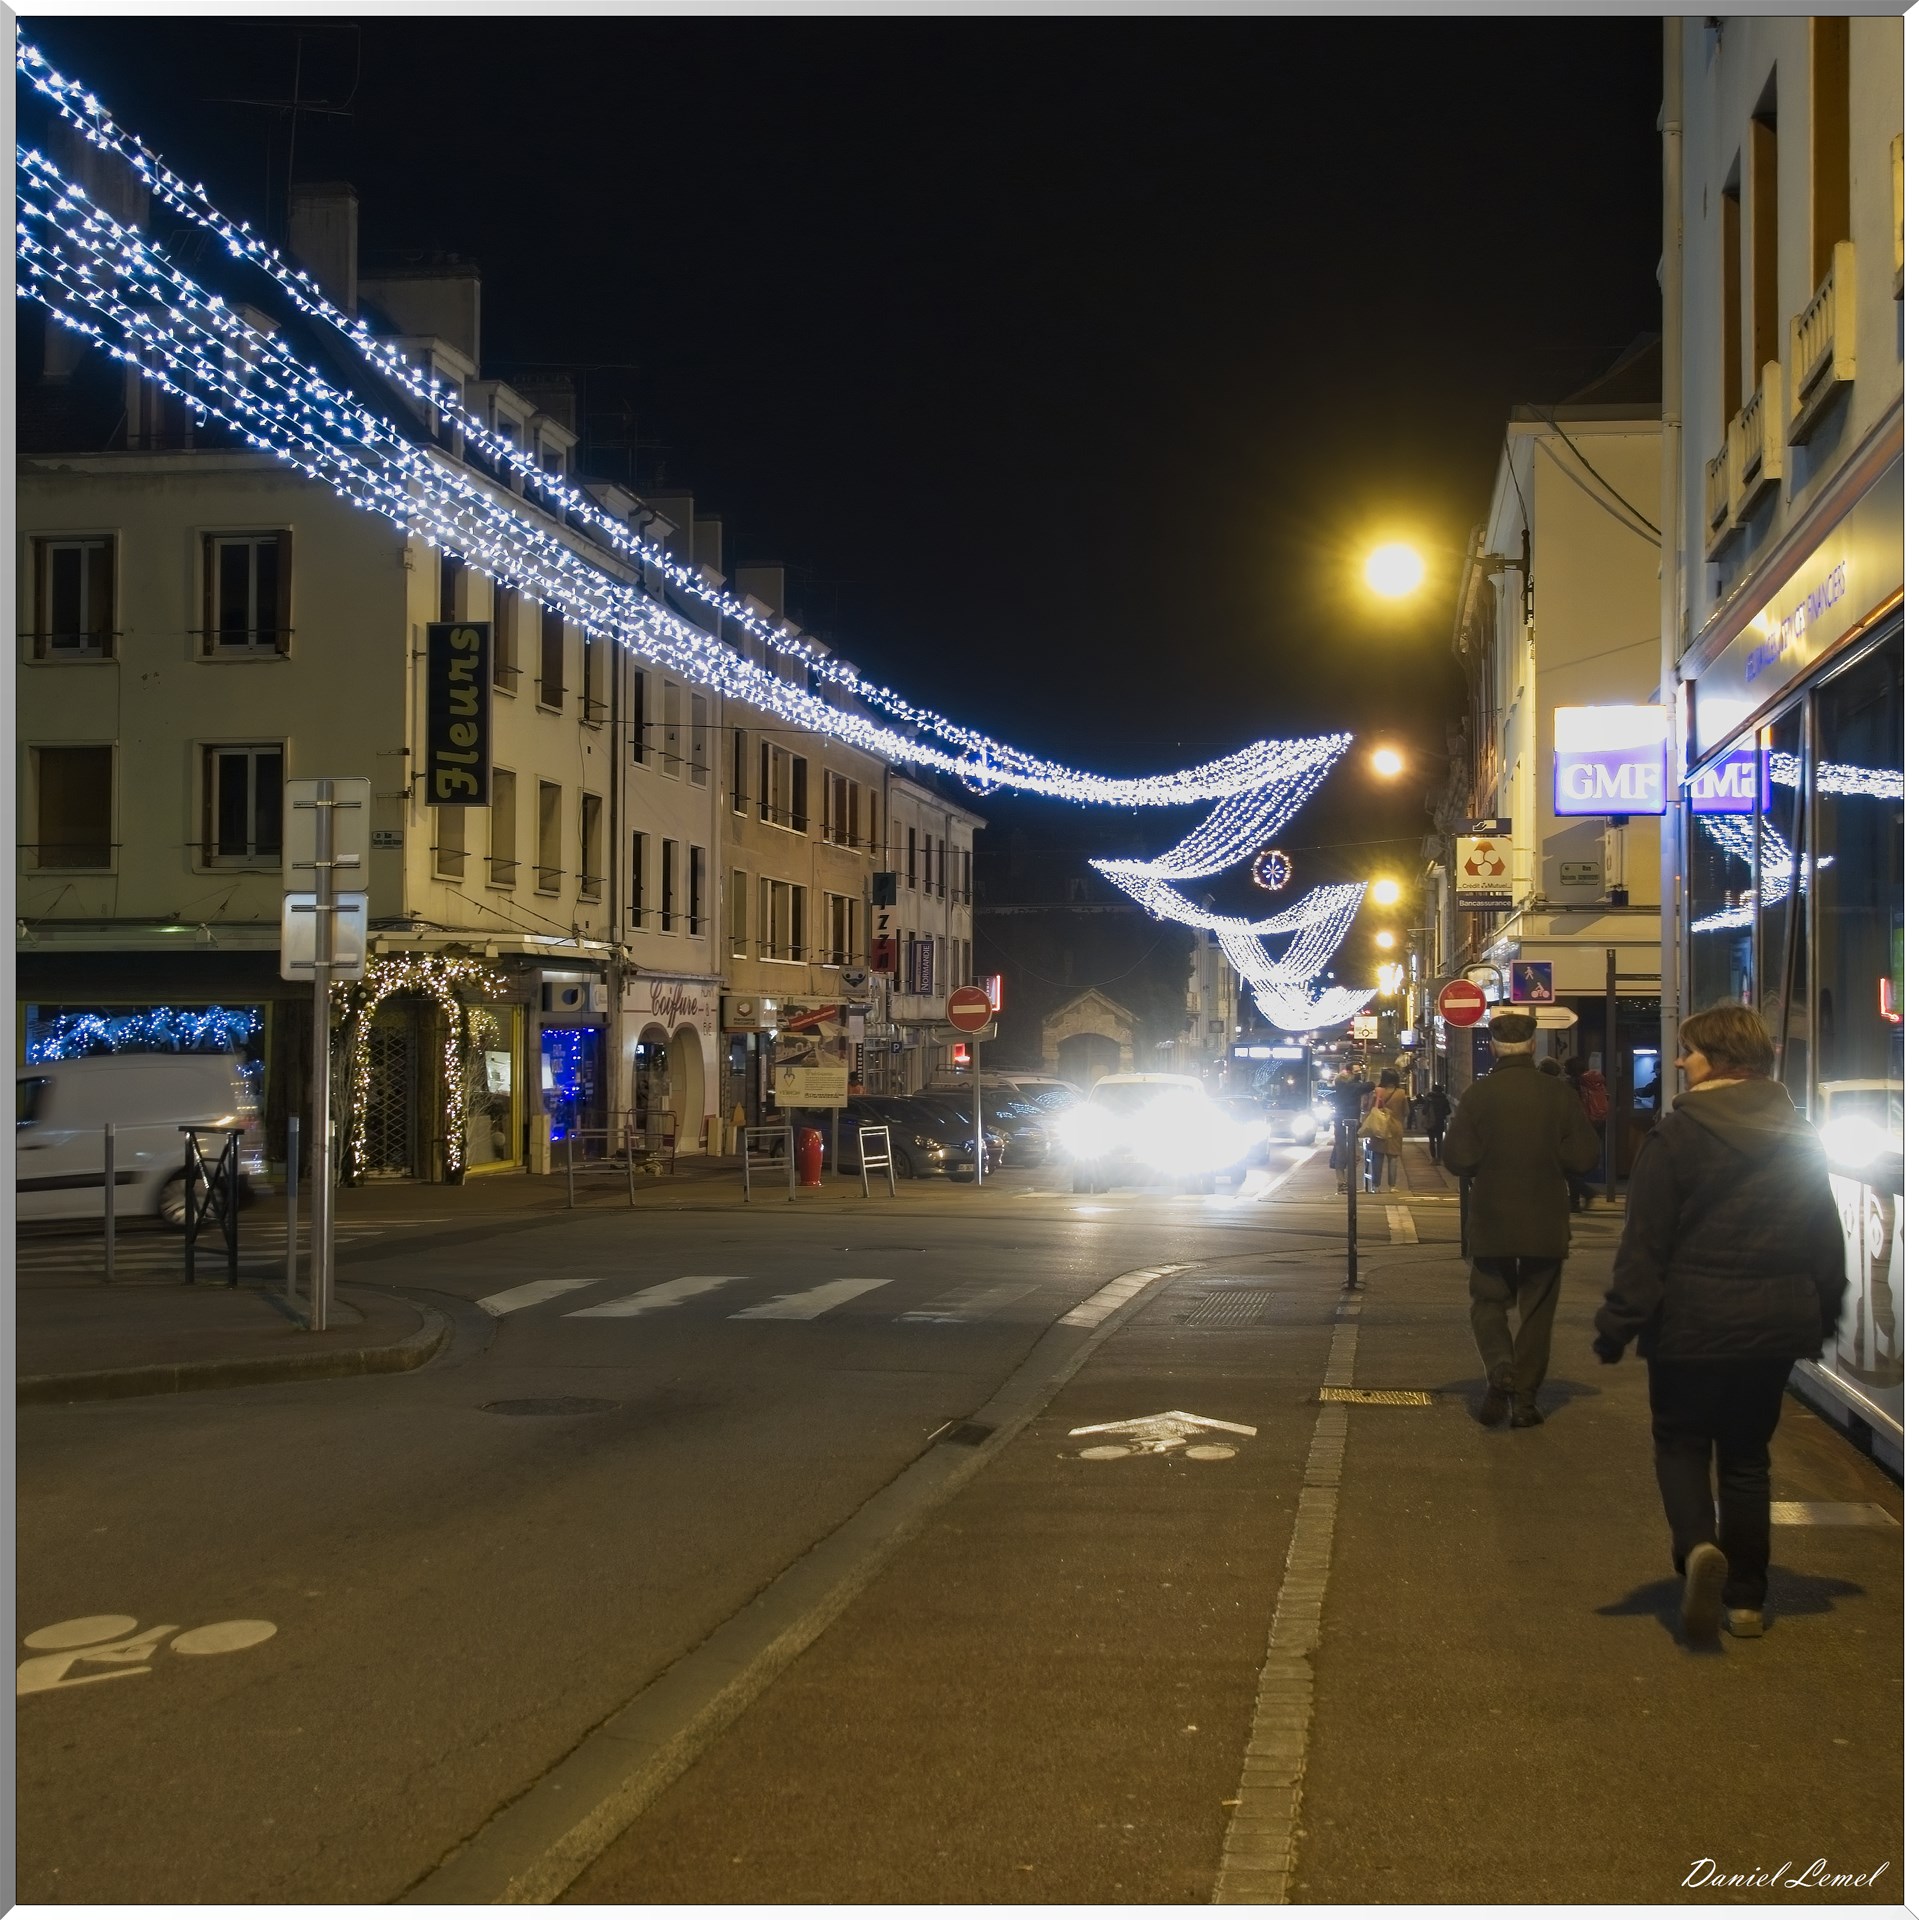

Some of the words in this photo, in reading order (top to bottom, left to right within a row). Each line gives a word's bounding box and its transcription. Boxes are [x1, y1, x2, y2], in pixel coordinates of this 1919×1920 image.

[436, 627, 480, 799] Fleurs
[1562, 762, 1661, 800] GMF
[1459, 899, 1512, 907] Bancassurance
[921, 945, 931, 991] NORMANDIE
[650, 979, 698, 1028] Coiffure
[893, 1043, 900, 1052] P
